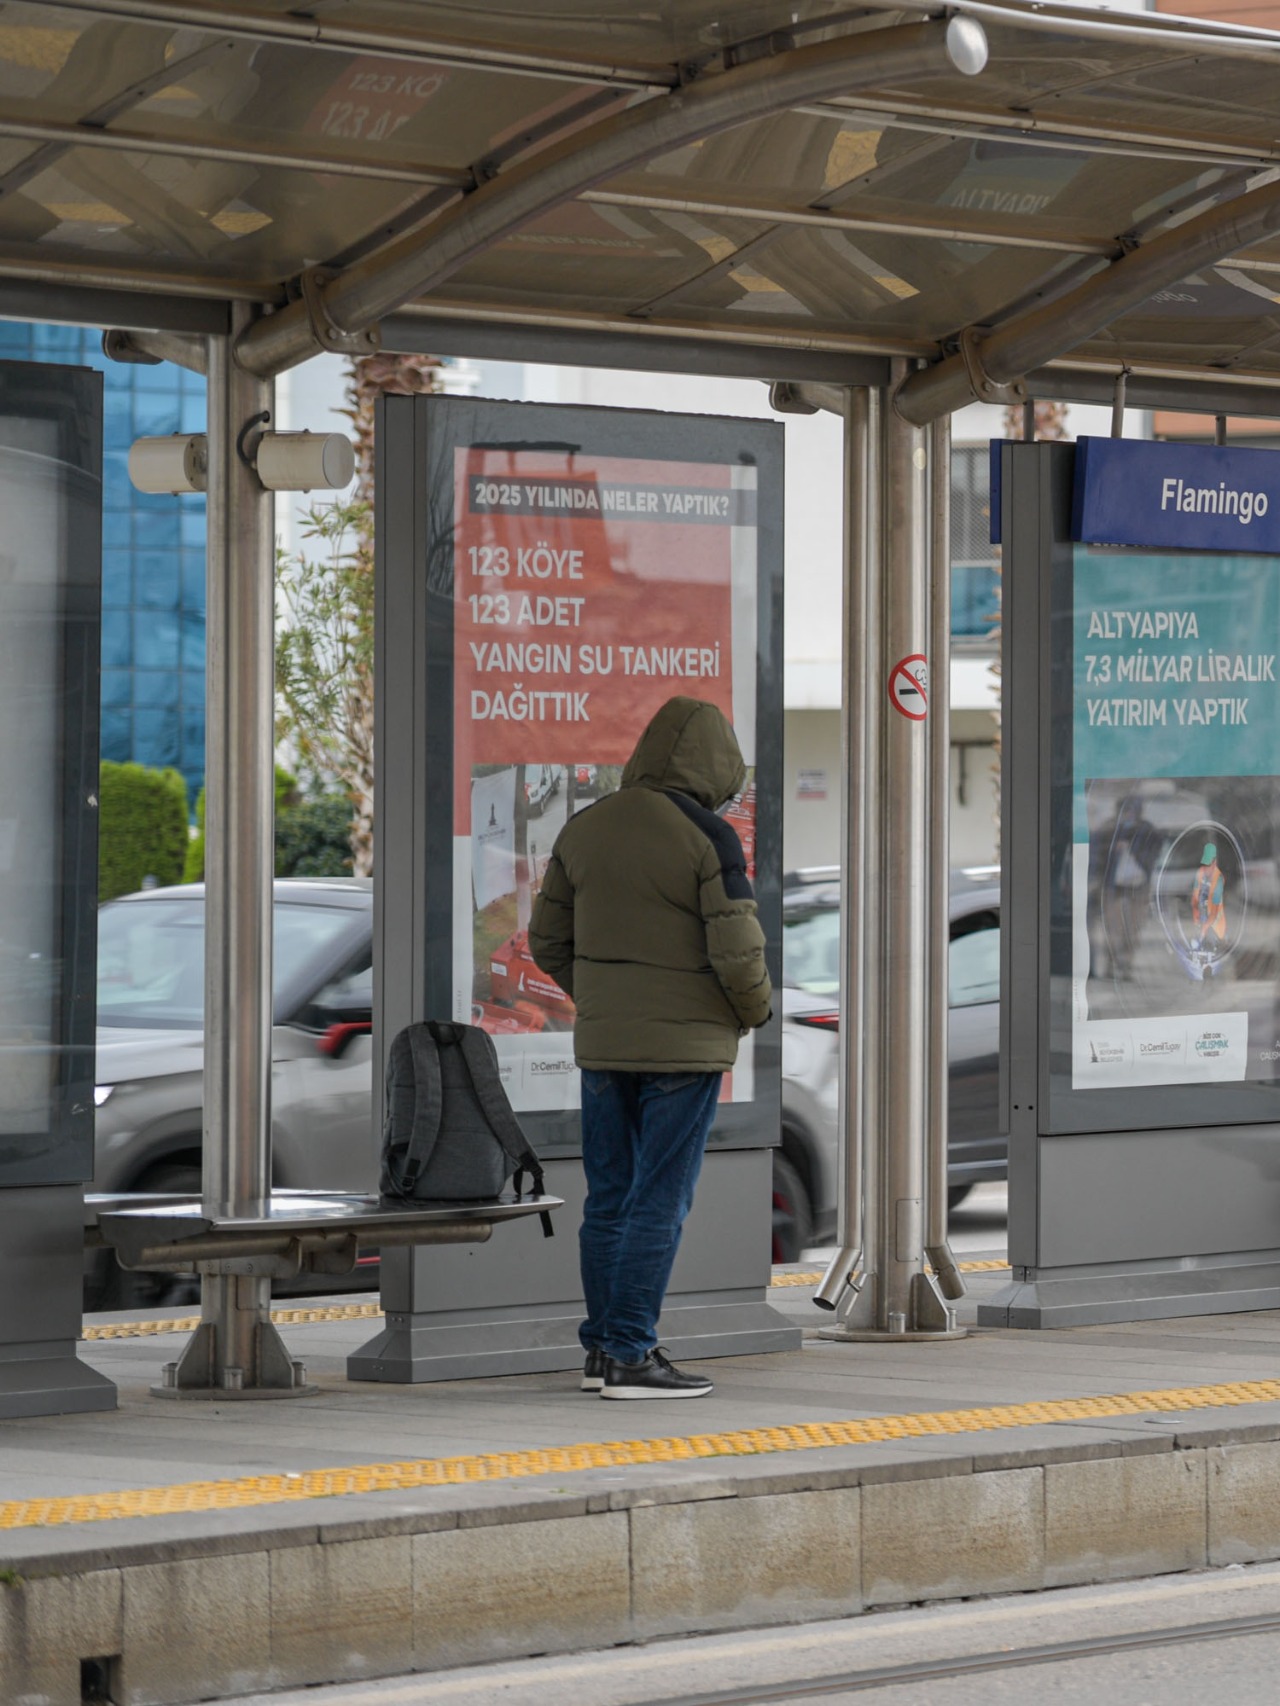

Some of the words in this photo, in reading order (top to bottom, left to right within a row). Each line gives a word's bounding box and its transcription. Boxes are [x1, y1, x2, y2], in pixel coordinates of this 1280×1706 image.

[474, 483, 521, 506] 2025
[524, 485, 599, 510] YILINDA
[602, 490, 658, 513] NELER
[662, 492, 729, 516] YAPTIK?
[1160, 477, 1268, 524] Flamingo
[467, 545, 510, 577] 123
[516, 540, 584, 579] KÖYE
[467, 593, 510, 625] 123
[516, 595, 585, 626] ADET
[1086, 611, 1199, 639] ALTYAPIYA
[469, 641, 571, 674] YANGIN
[578, 645, 613, 675] SU
[619, 640, 720, 678] TANKERİ
[1084, 654, 1112, 687] 7,3
[1117, 648, 1192, 682] MİLYAR
[1197, 648, 1276, 683] LİRALIK
[470, 682, 590, 721] DAĞITTIK
[1086, 699, 1167, 726] YATIRIM
[1172, 698, 1249, 725] YAPTIK
